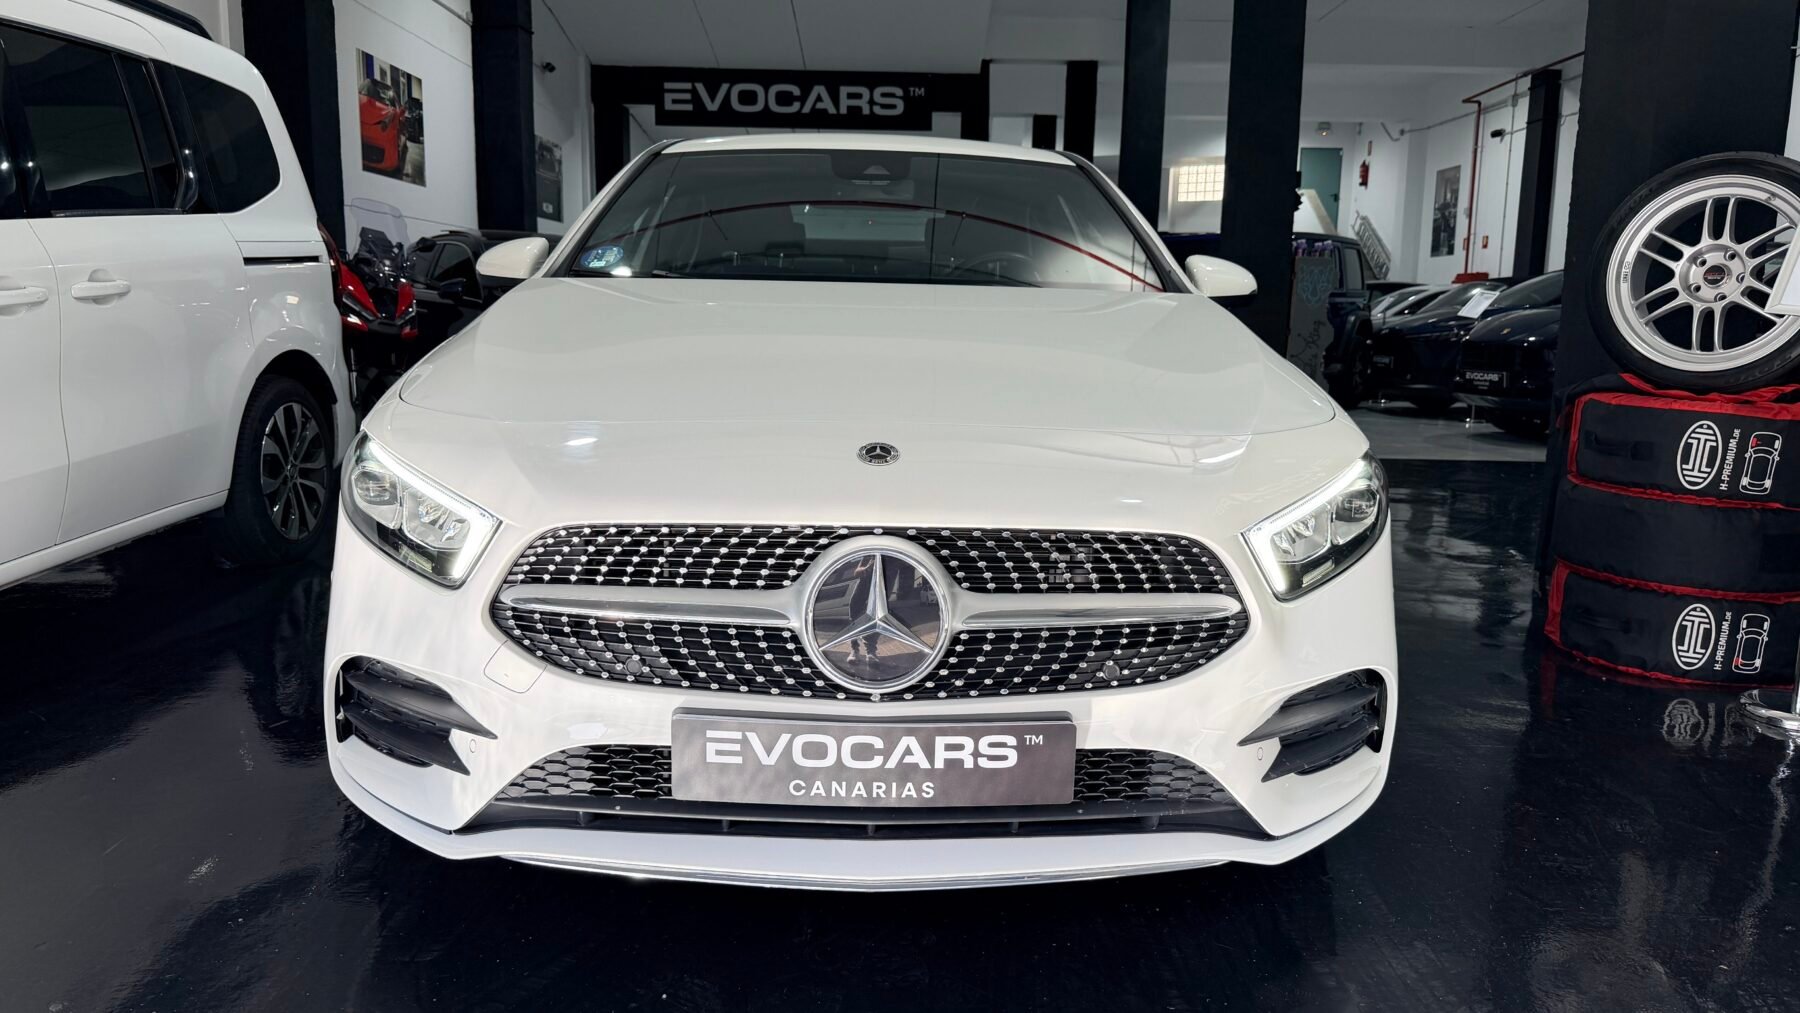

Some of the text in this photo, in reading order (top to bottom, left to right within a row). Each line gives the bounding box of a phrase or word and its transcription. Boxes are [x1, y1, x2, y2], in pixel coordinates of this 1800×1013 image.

[664, 82, 904, 115] EVOCARS
[1719, 428, 1741, 491] H-PREMIUM.DE
[1713, 611, 1732, 671] H-PREMIUM.DE
[706, 730, 1018, 769] EVOCARS
[789, 780, 935, 798] CANARIAS
